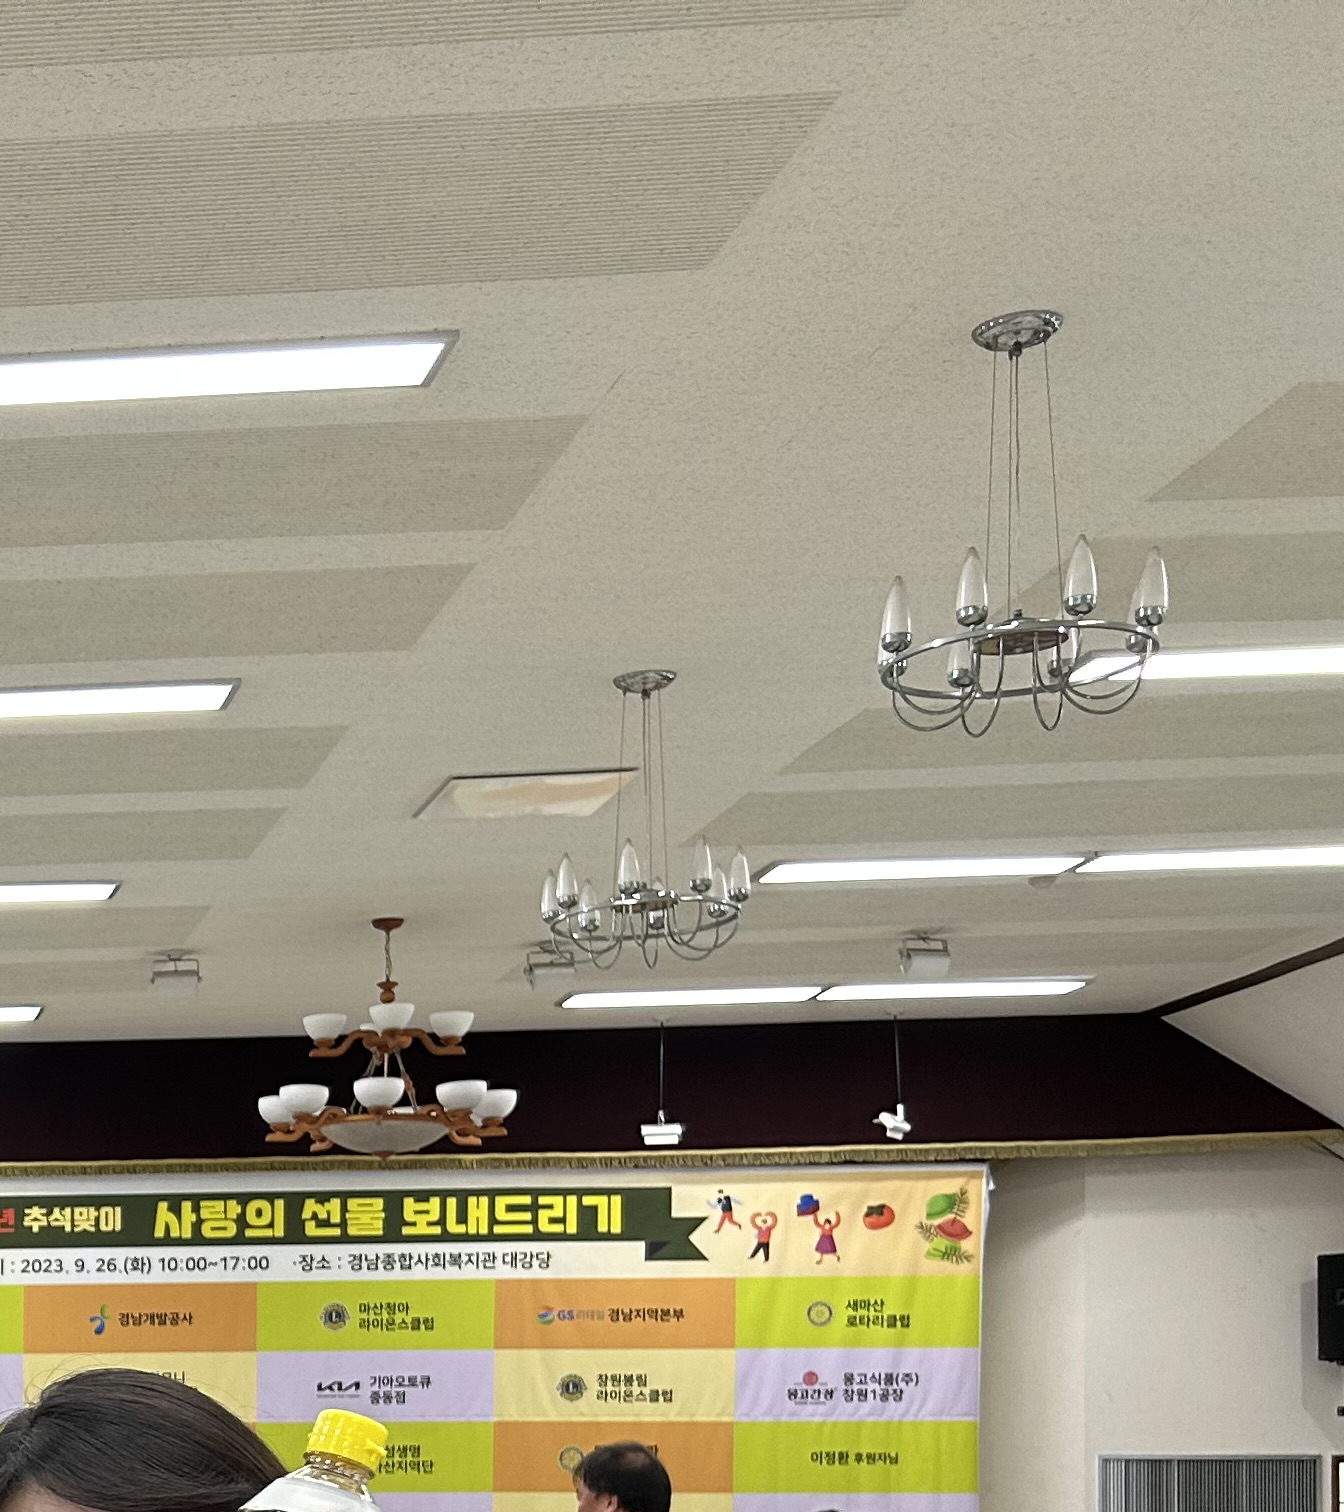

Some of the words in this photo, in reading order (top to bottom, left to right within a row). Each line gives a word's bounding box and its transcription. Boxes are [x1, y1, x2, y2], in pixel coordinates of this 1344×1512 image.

[23, 1206, 122, 1232] 추석맞이
[153, 1198, 286, 1239] 사랑의
[301, 1197, 386, 1238] 선물
[401, 1194, 622, 1236] 보내드리기
[158, 1255, 270, 1273] 10:00~17:00
[298, 1253, 332, 1273] 장소
[348, 1251, 498, 1272] 경남종합사회복지관
[501, 1250, 552, 1270] 대강당
[118, 1311, 193, 1327] 경남개발공사
[608, 1307, 685, 1323] 경남지역본부
[358, 1316, 435, 1332] 라이온스클럽
[596, 1388, 674, 1404] 라이온스클럽
